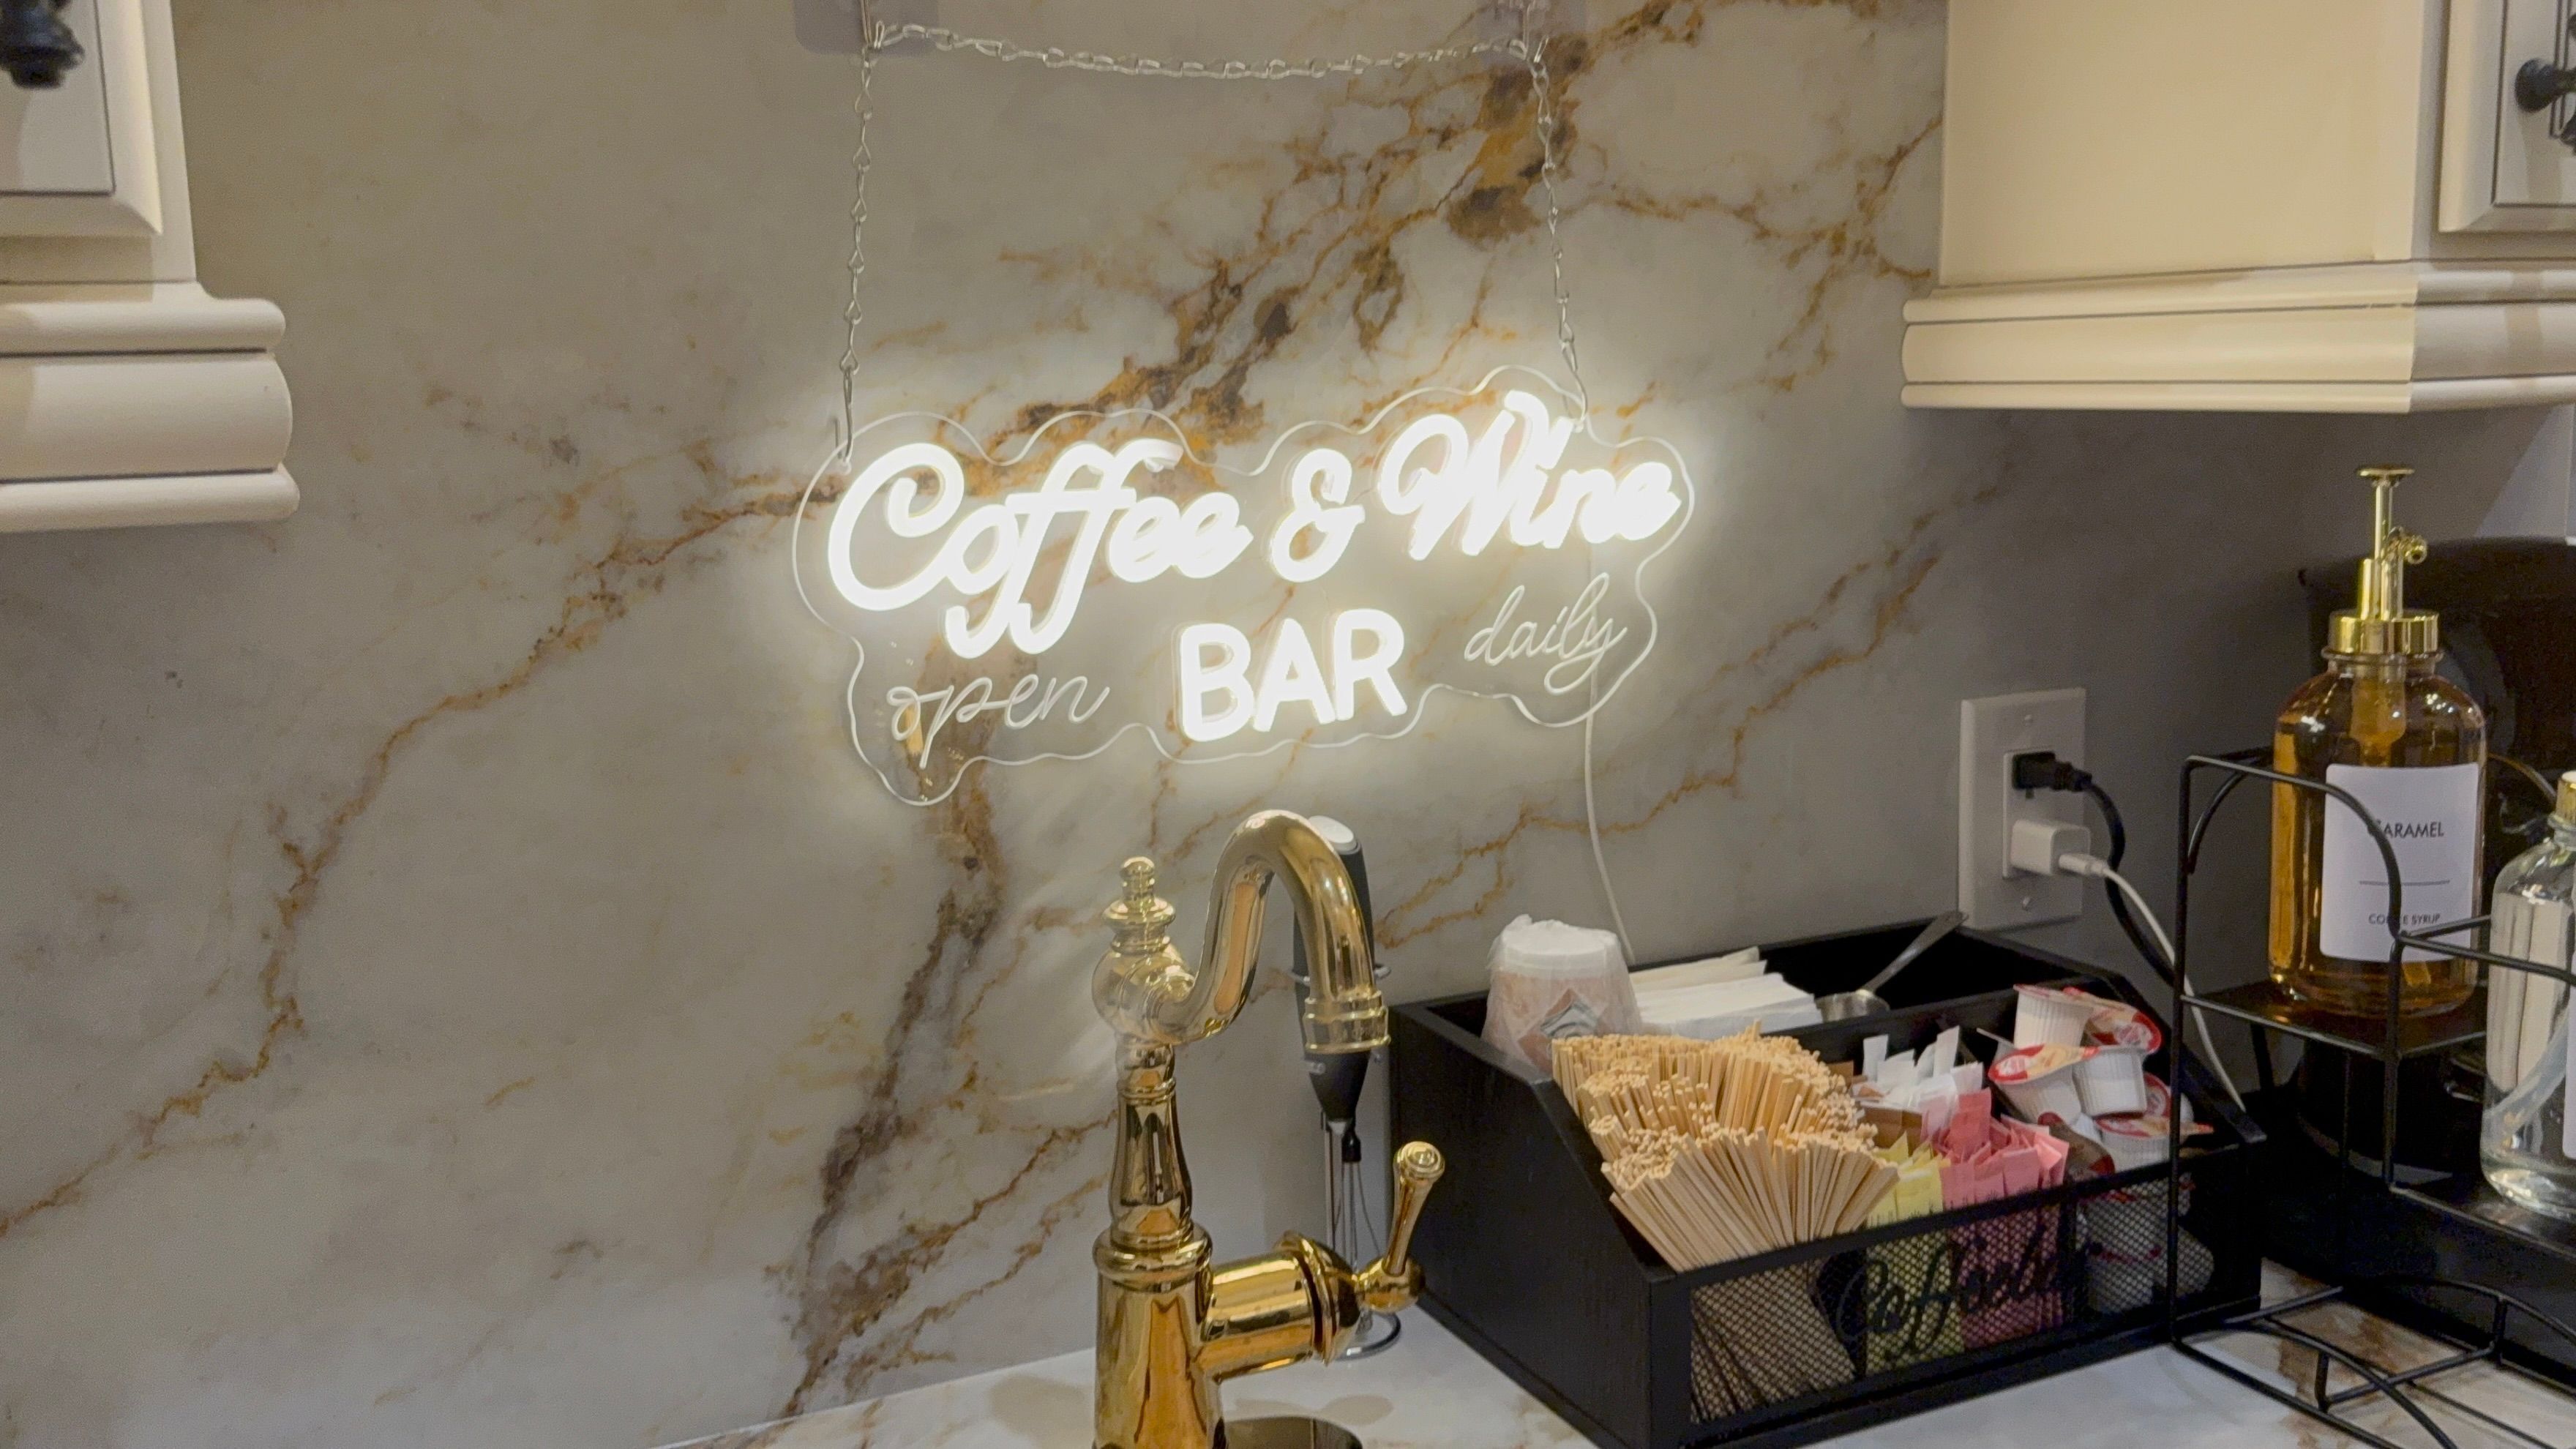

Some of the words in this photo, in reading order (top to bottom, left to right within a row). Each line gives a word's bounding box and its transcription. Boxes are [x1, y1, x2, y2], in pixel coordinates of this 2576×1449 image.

[828, 438, 1254, 659] Coffee
[1272, 449, 1365, 583] &
[1377, 390, 1682, 561] Wine
[1180, 609, 1407, 742] BAR
[1464, 572, 1628, 694] daily
[886, 674, 1110, 769] open
